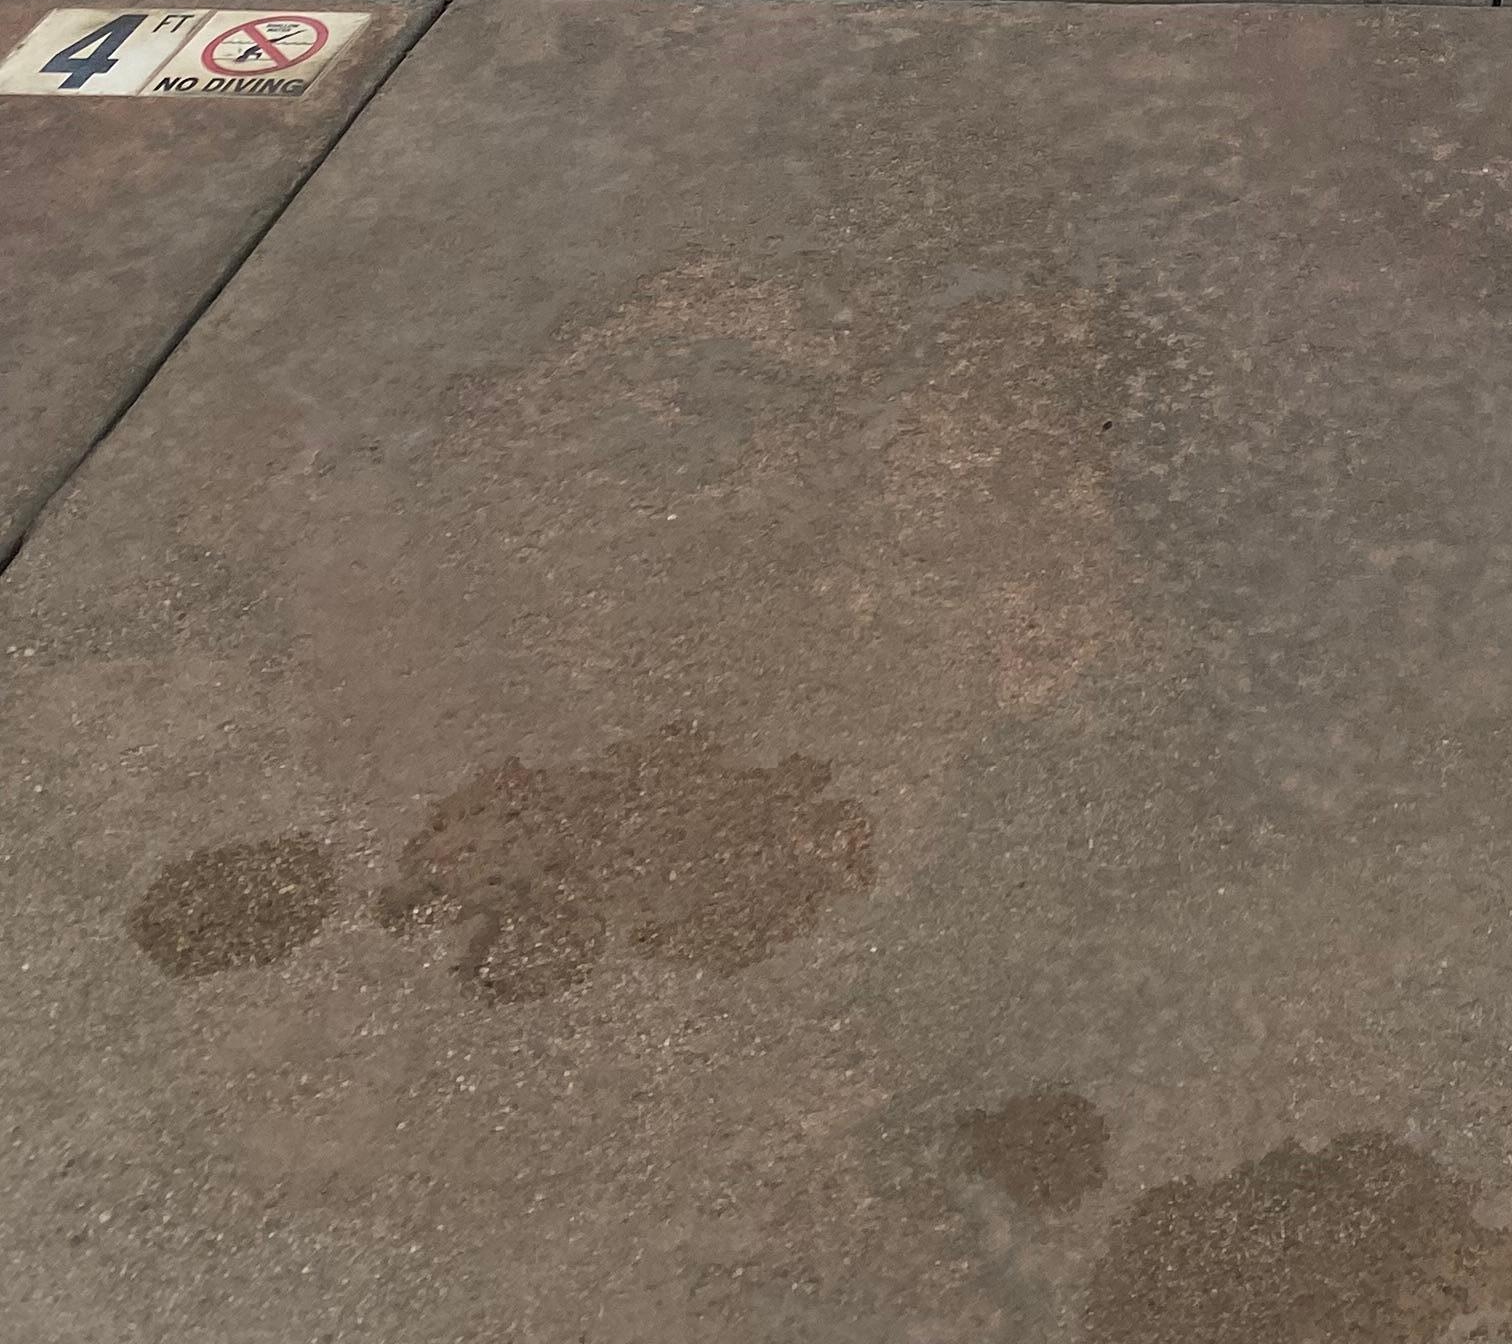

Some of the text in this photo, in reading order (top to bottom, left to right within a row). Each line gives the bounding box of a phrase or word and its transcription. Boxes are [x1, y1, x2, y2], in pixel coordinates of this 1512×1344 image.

[39, 14, 194, 89] 4 FT
[153, 77, 307, 94] NO DIVING
